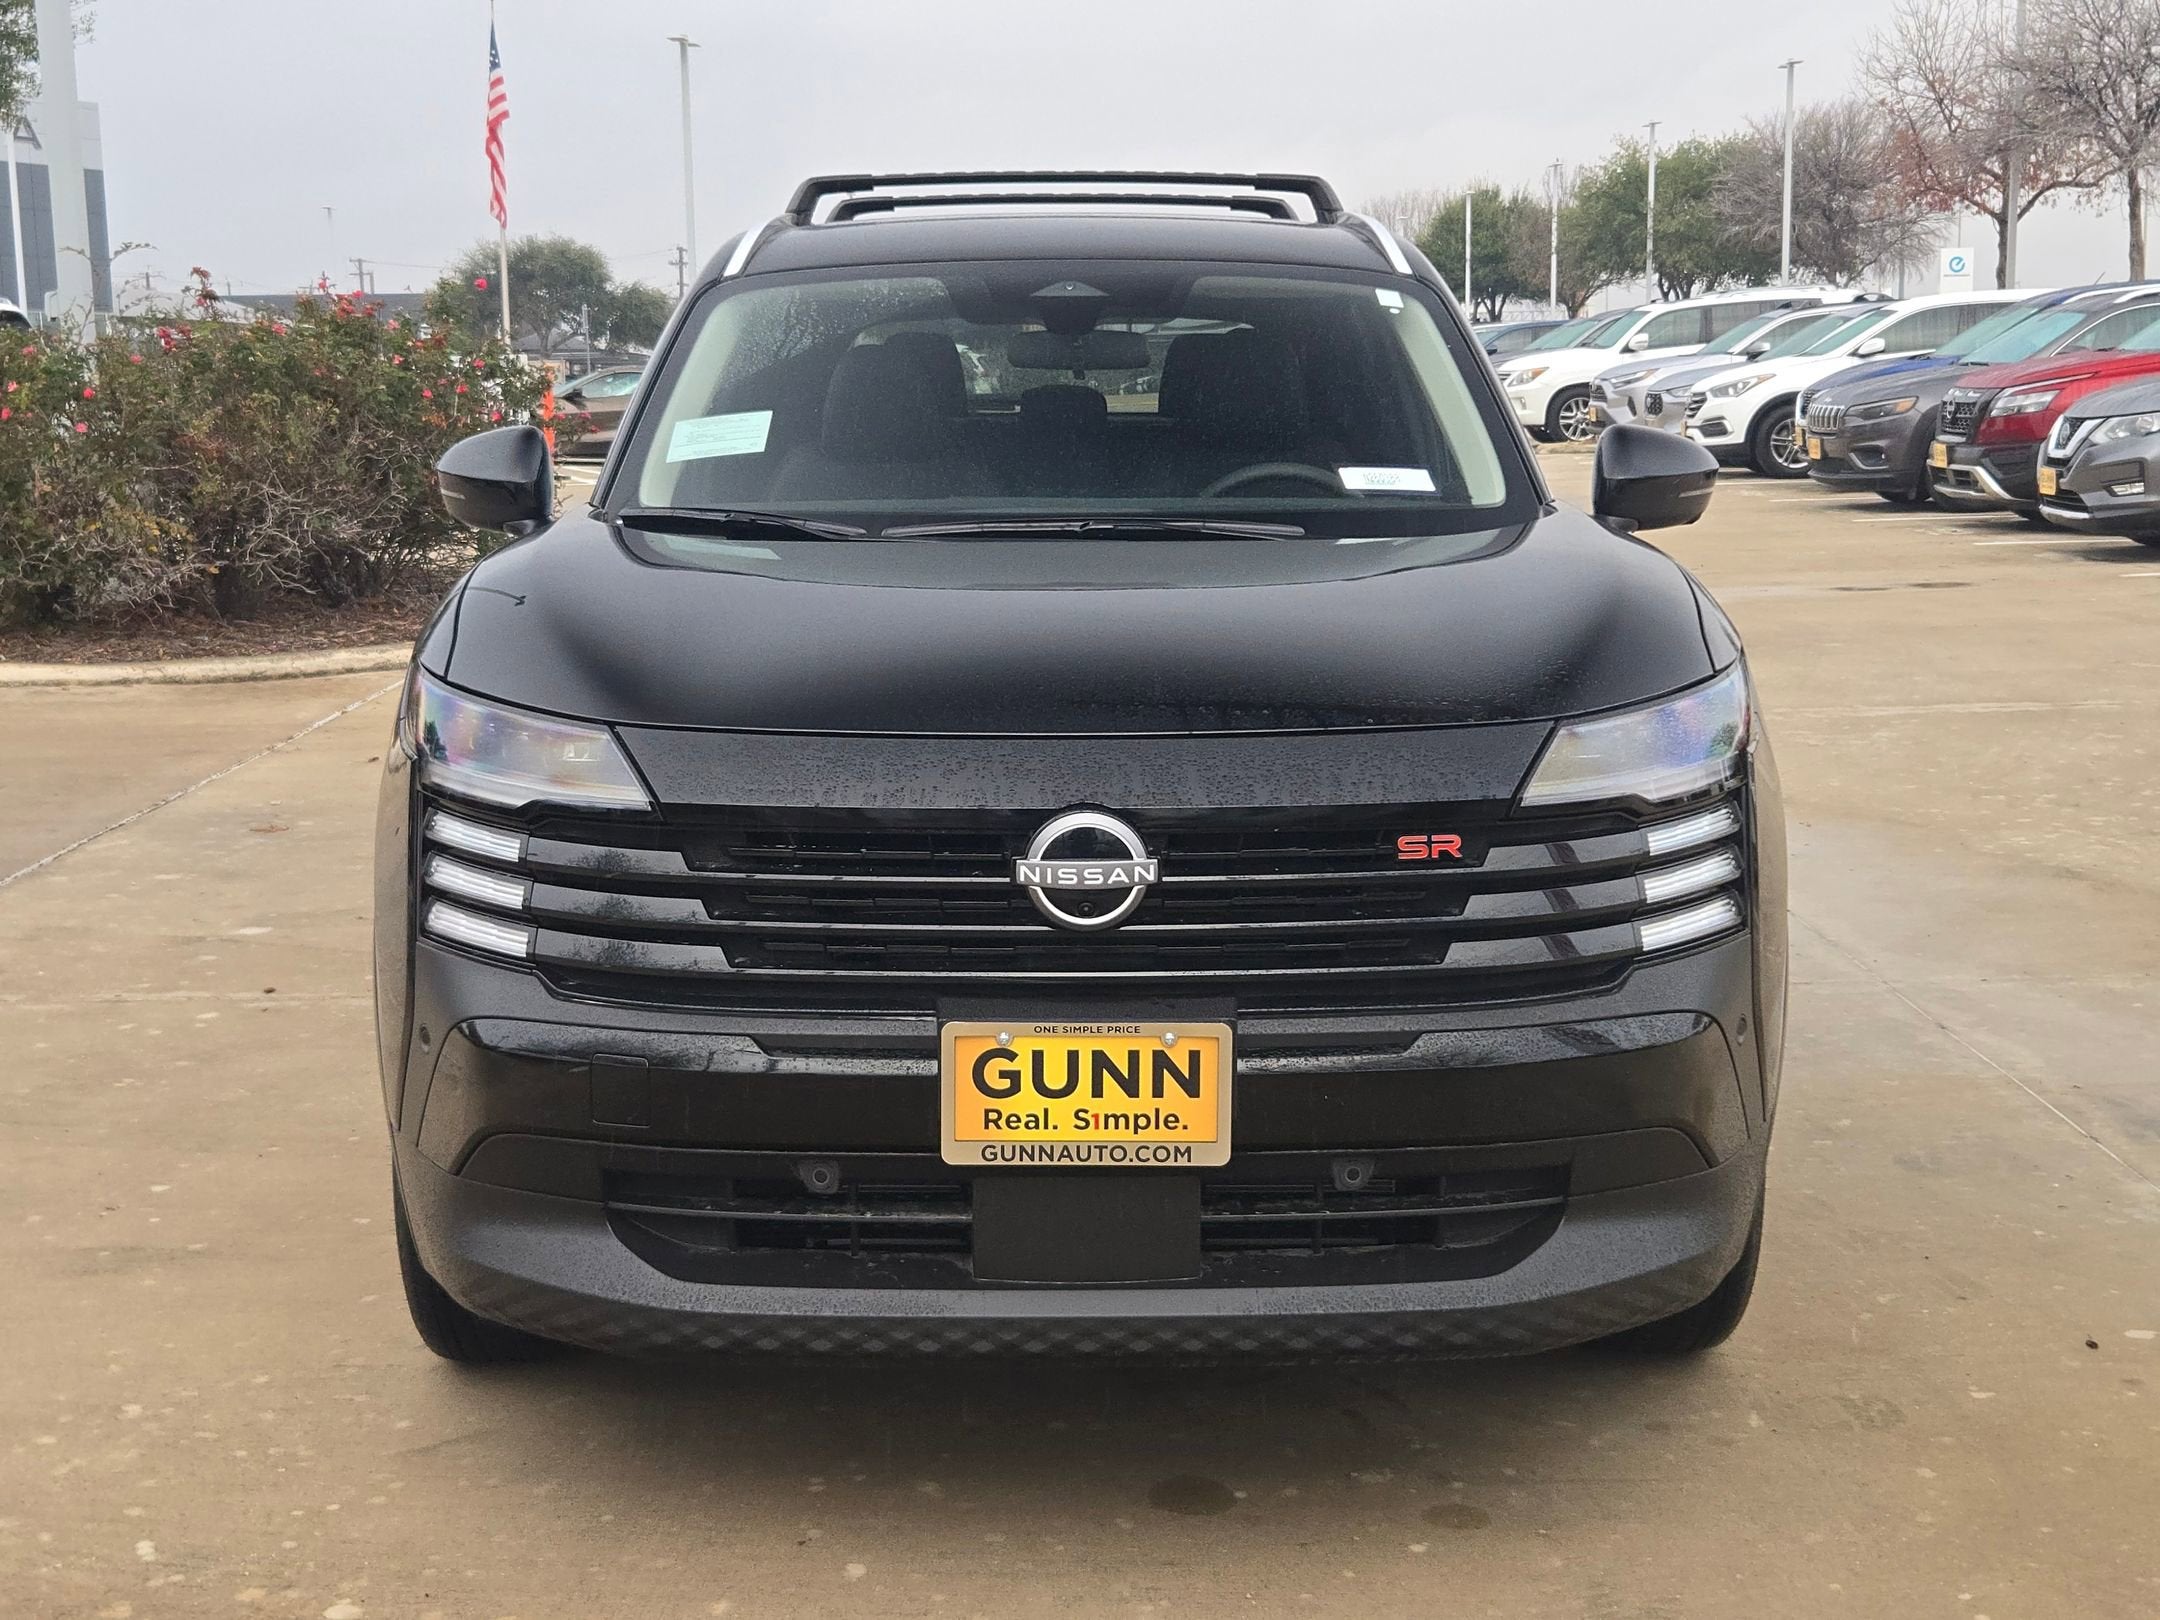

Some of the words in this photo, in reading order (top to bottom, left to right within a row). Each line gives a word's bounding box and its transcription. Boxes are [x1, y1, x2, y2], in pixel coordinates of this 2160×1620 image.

[1397, 834, 1463, 860] SR
[1019, 864, 1155, 886] NISSAN
[1033, 1025, 1059, 1034] ONE
[1107, 1025, 1141, 1034] PRICE
[971, 1047, 1201, 1099] GUNN
[983, 1107, 1058, 1130] Real.
[981, 1144, 1192, 1163] GUNNAUTO.COM
